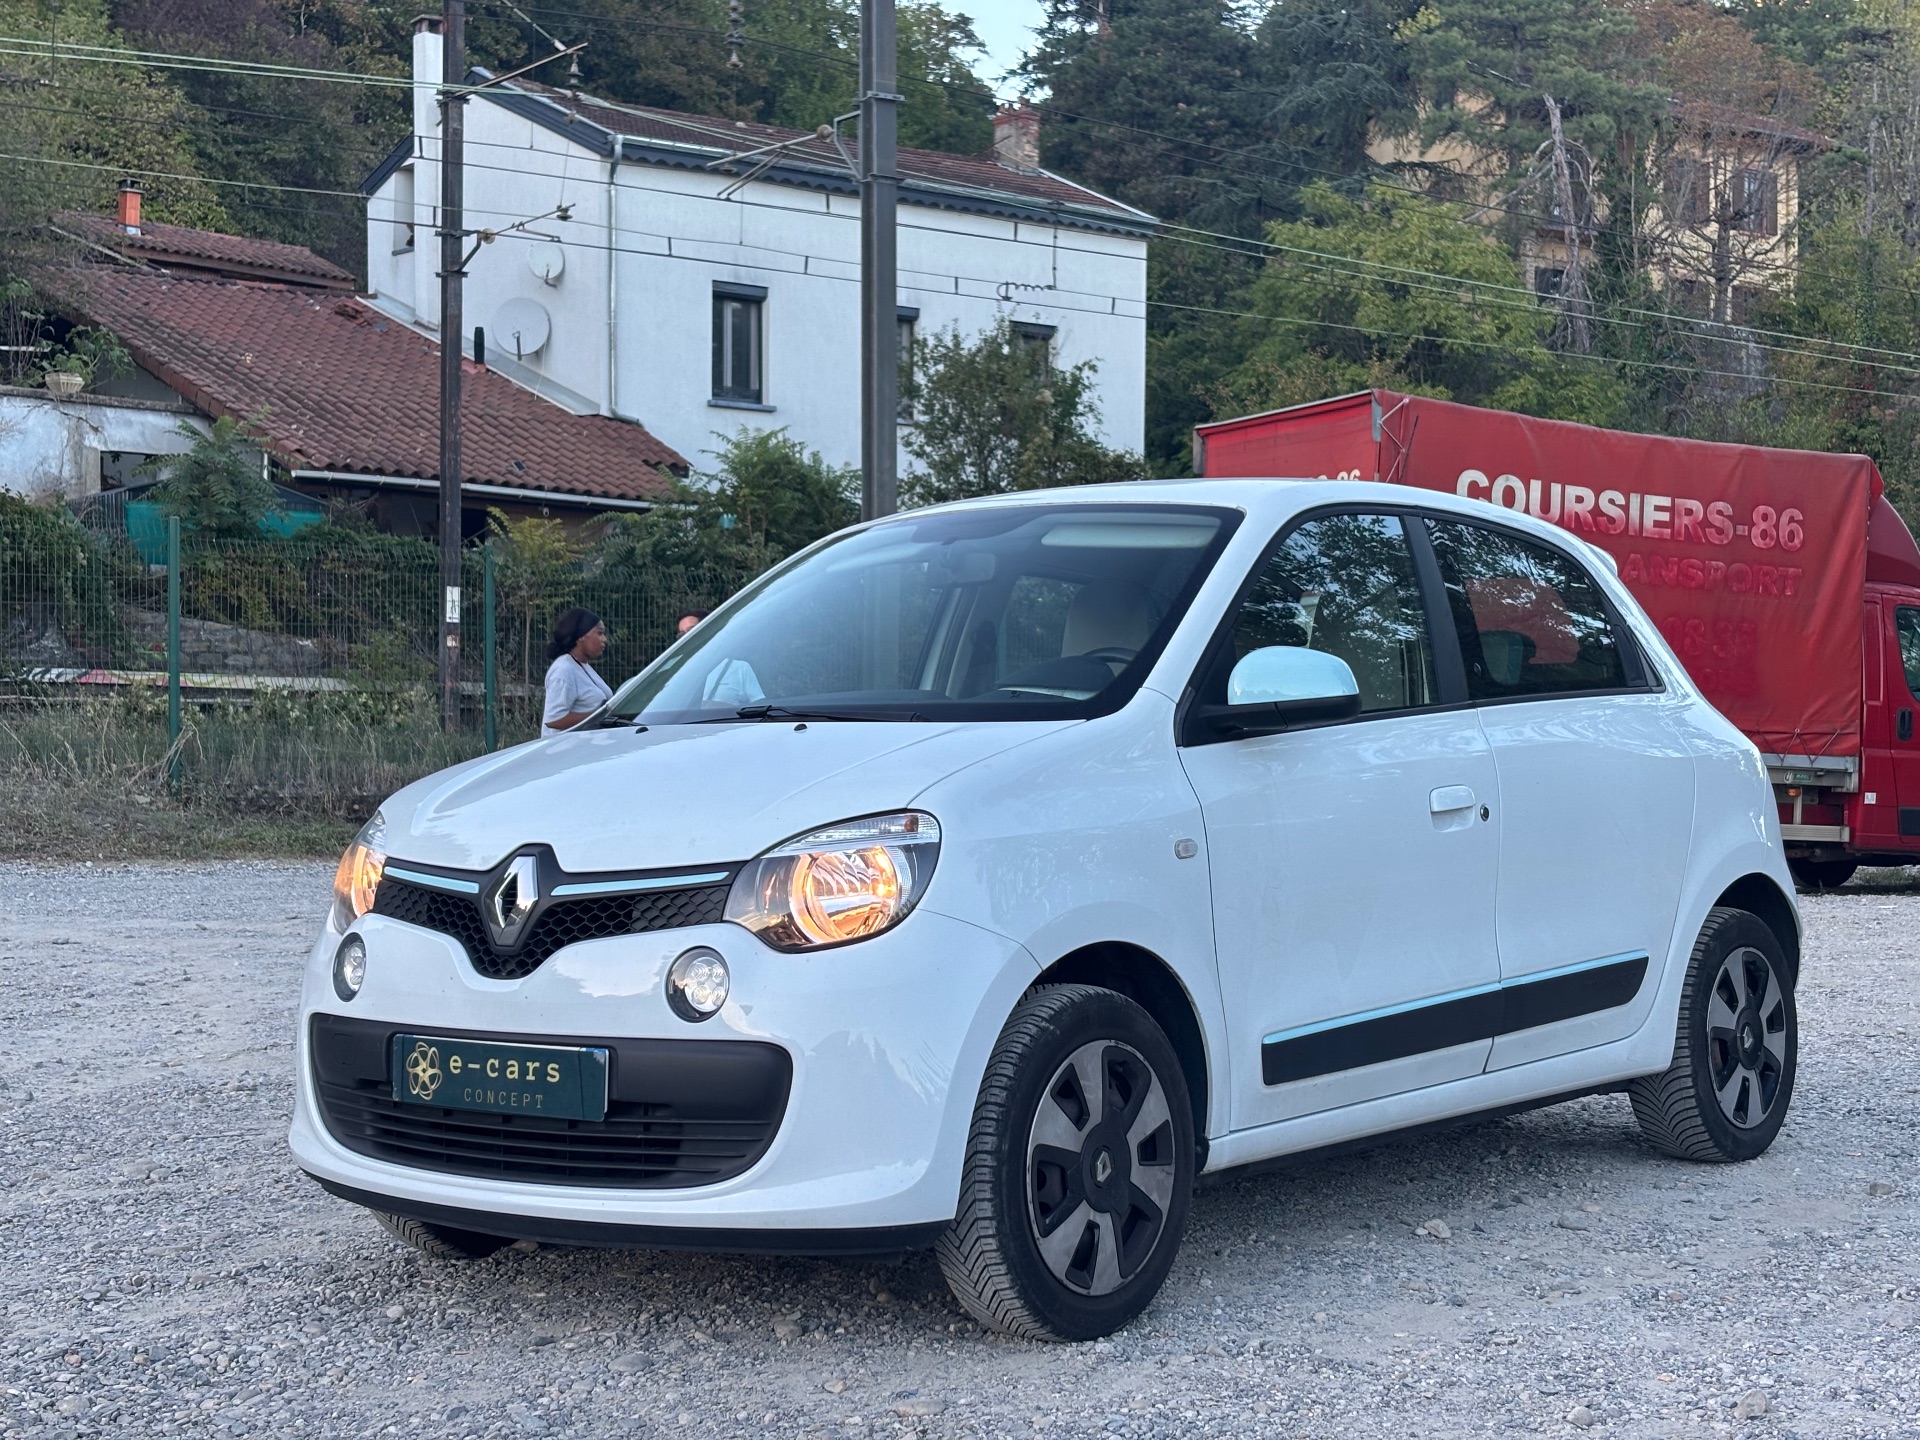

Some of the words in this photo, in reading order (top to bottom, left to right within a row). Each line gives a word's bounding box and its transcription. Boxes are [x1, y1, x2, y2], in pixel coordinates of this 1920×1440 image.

[1456, 469, 1804, 551] COURSIERS-86
[449, 1054, 560, 1083] e-cars
[463, 1088, 544, 1109] CONCEPT
